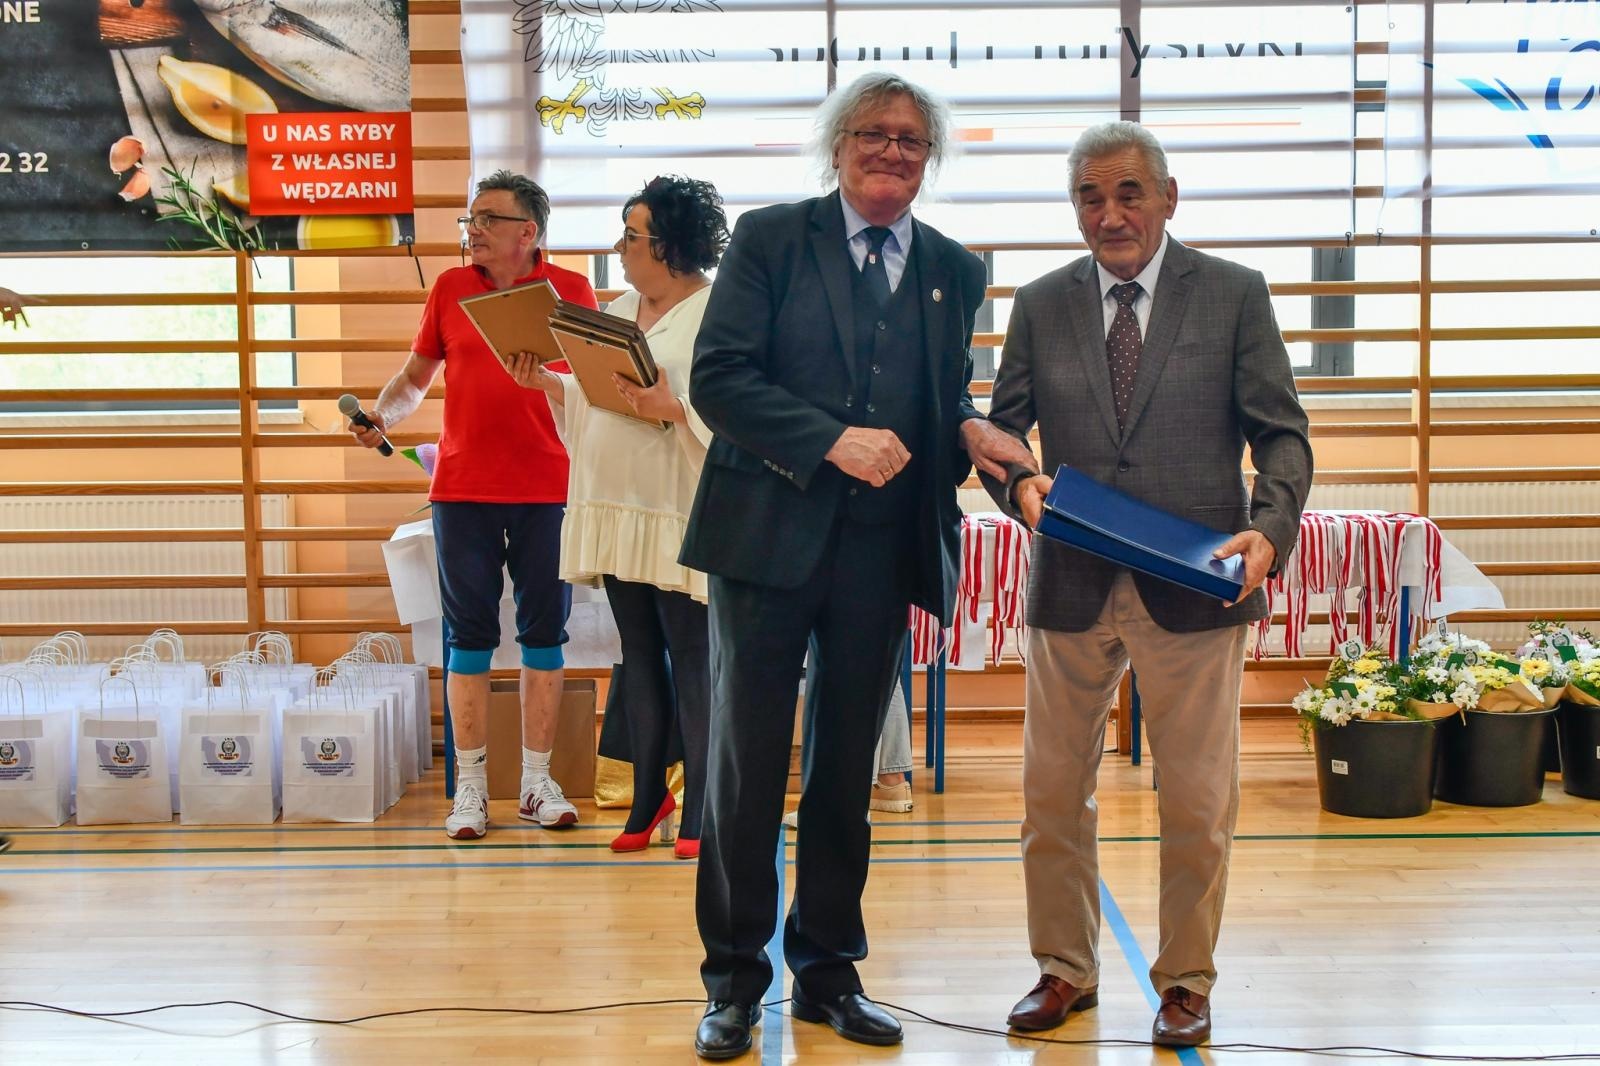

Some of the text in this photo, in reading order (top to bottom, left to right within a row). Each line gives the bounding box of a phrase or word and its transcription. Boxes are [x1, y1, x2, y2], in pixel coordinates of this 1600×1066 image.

[0, 1, 41, 23] NE
[262, 123, 396, 142] U NAS RYBY
[18, 152, 49, 173] 32
[271, 153, 397, 171] Z WŁASNEJ
[281, 181, 398, 203] WĘDZARNI
